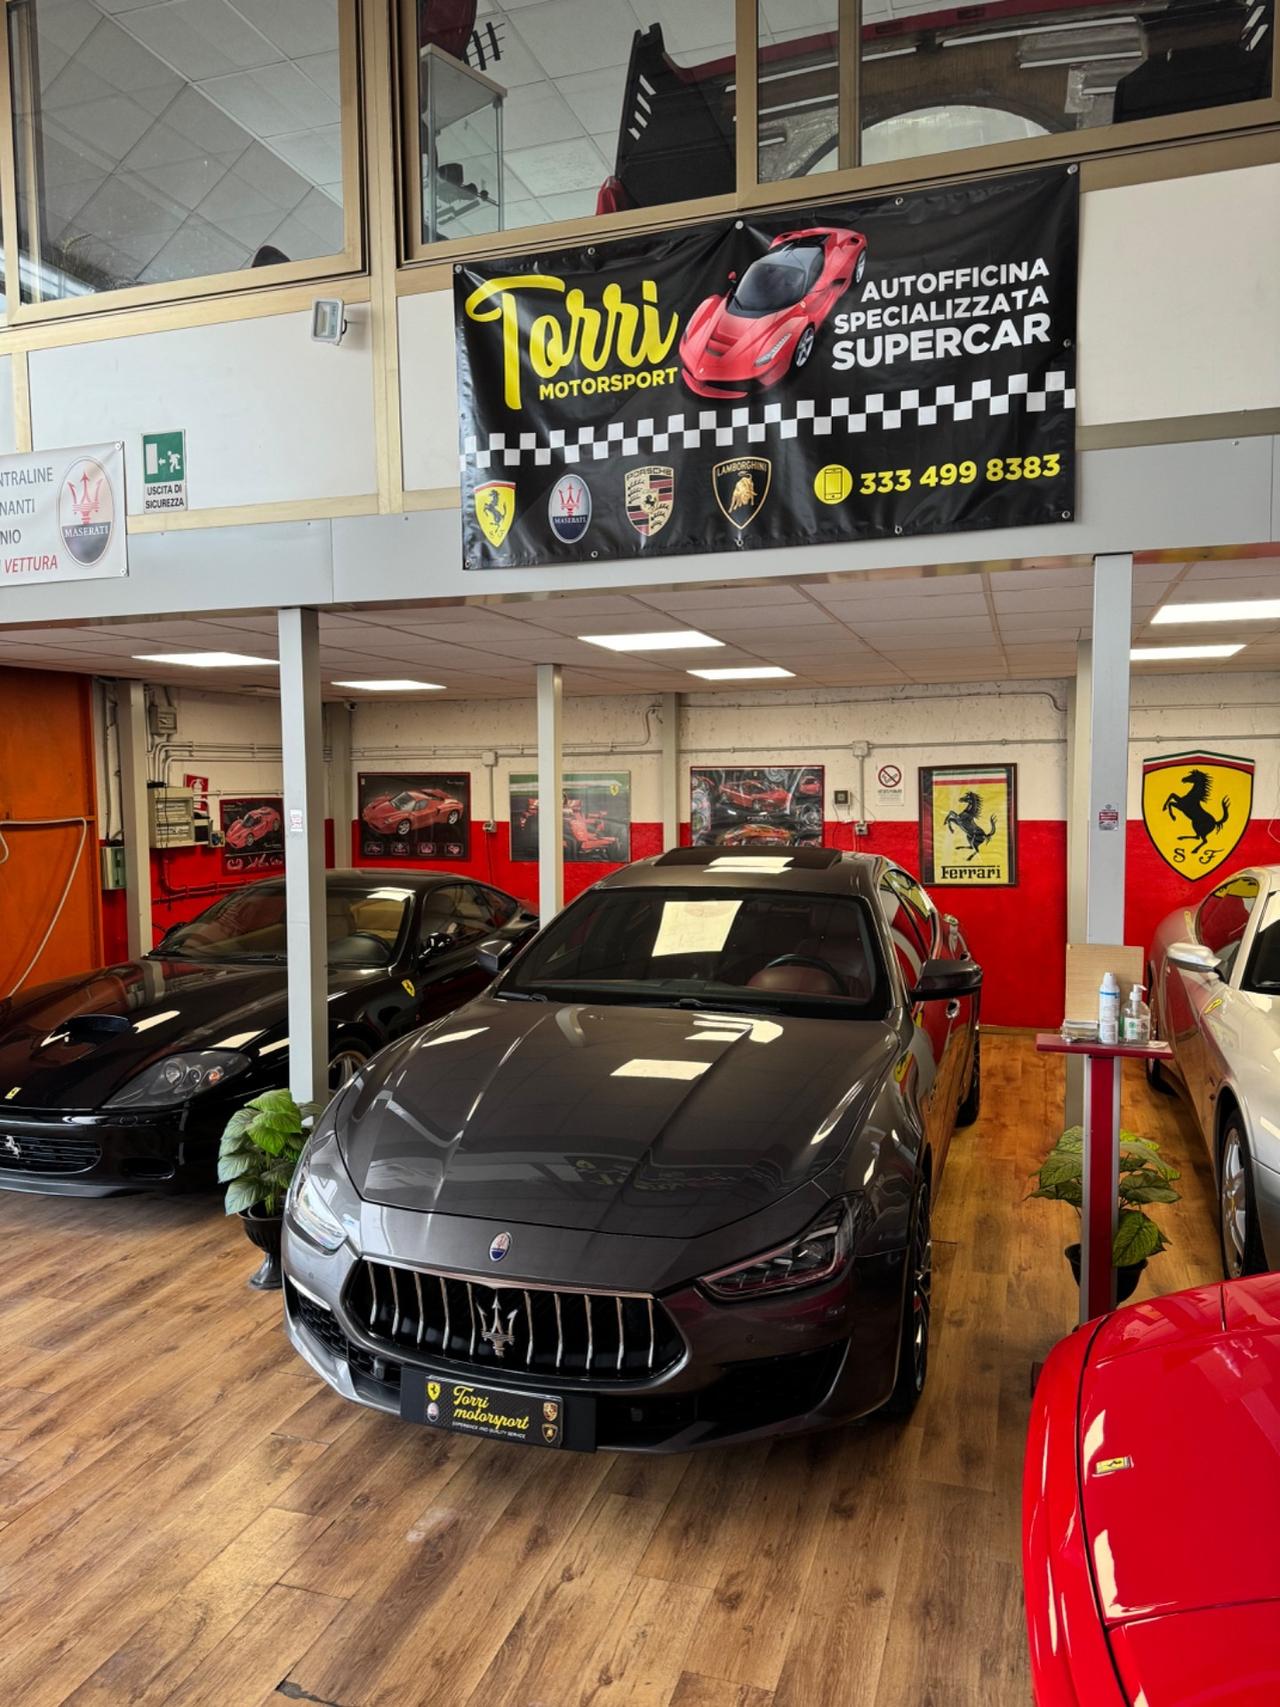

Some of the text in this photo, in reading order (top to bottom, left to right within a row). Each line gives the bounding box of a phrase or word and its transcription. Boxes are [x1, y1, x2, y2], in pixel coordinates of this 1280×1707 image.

[861, 258, 1050, 303] AUTOFFICINA
[834, 285, 1050, 334] SPECIALIZZATA
[465, 274, 679, 411] Torri
[832, 312, 1052, 371] SUPERCAR
[539, 367, 679, 400] MOTORSPORT
[626, 467, 673, 480] PORSCHE
[716, 460, 767, 477] LAMBORGHINI
[859, 453, 1061, 495] 333 499 8383
[147, 484, 182, 495] USCITA DI
[145, 497, 184, 509] SICUREZZA
[64, 525, 109, 538] MASERATI
[4, 554, 58, 573] VETTURA
[1173, 848, 1224, 864] S F
[941, 865, 1001, 879] Ferrari
[453, 1386, 489, 1408] Torri
[453, 1408, 529, 1430] motorsport
